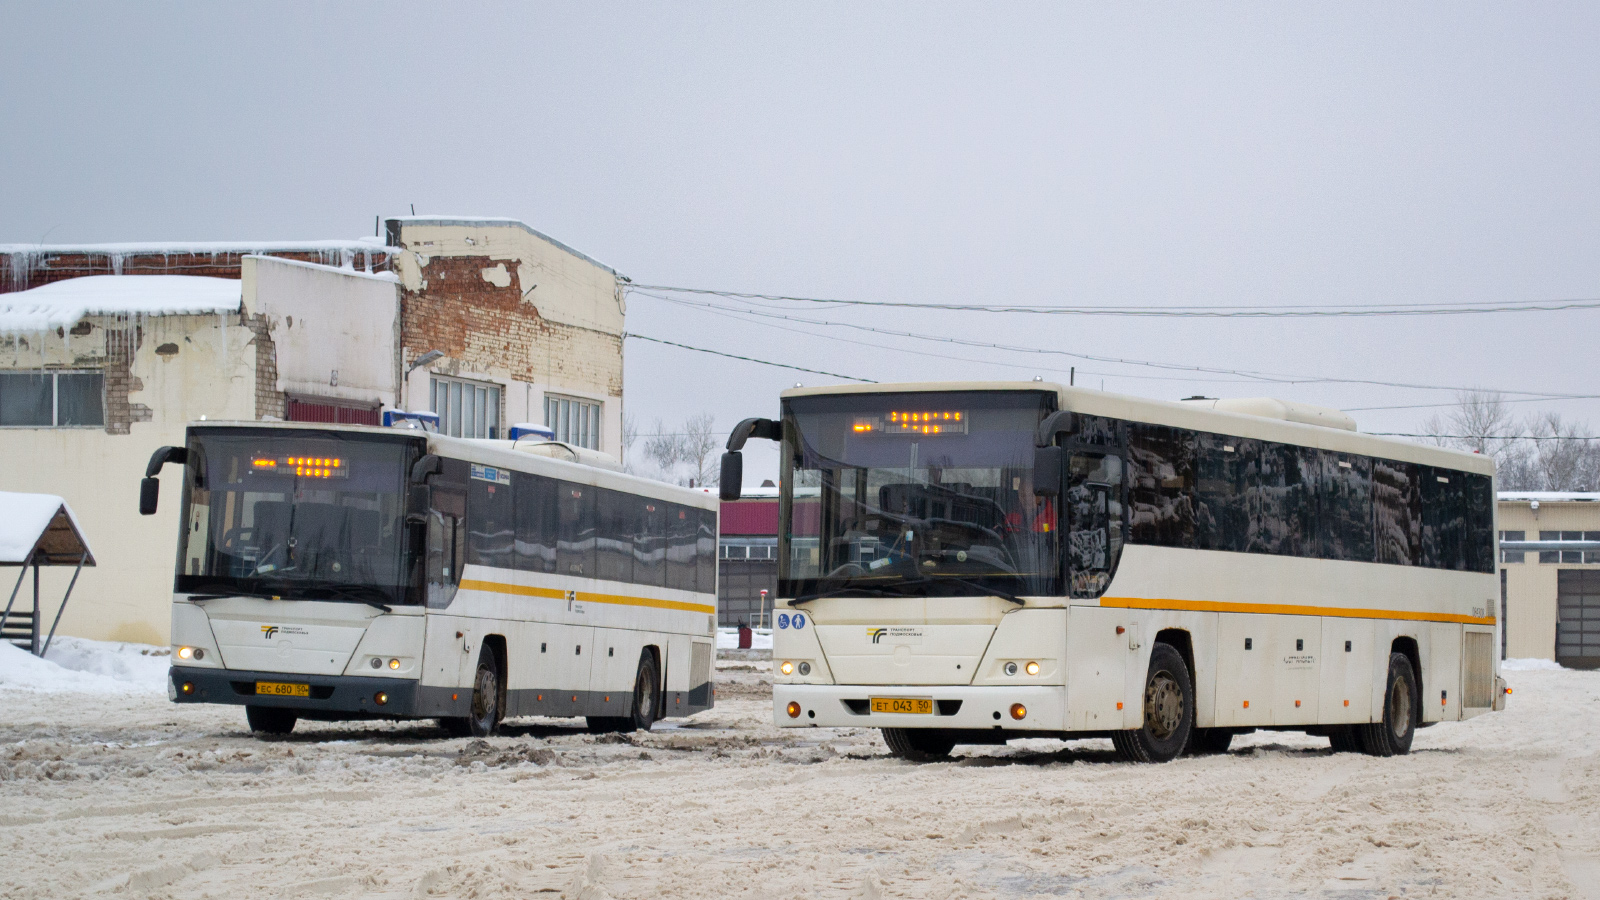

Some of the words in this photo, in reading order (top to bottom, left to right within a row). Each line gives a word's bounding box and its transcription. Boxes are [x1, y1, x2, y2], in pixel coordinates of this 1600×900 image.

[275, 685, 292, 694] 680
[893, 700, 912, 711] 043
[918, 701, 928, 709] 50
